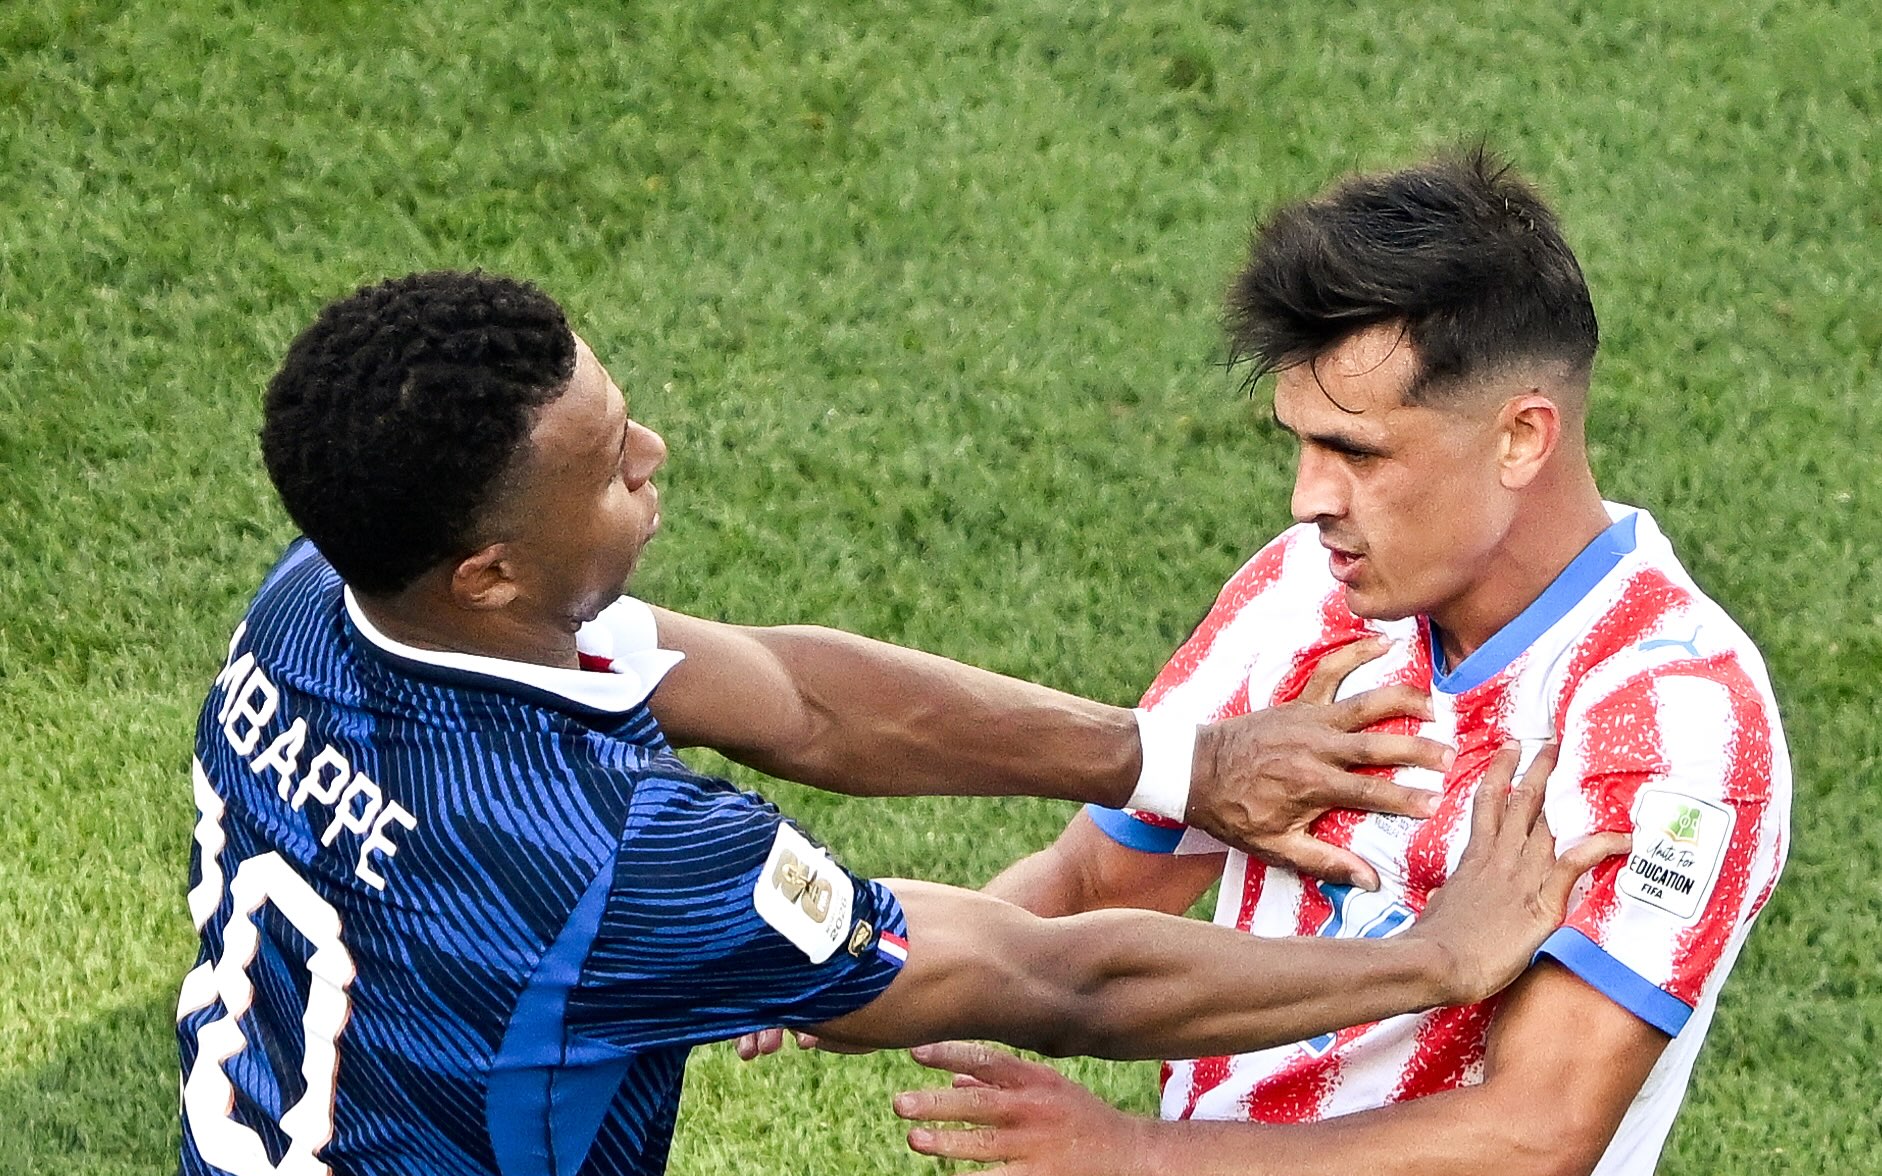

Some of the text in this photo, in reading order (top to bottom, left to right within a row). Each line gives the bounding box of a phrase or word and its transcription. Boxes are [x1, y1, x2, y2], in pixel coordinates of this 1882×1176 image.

[216, 620, 418, 891] MBAPPE
[1647, 839, 1696, 868] Unite For
[1630, 855, 1695, 895] EDUCATION
[1641, 883, 1664, 899] FIFA
